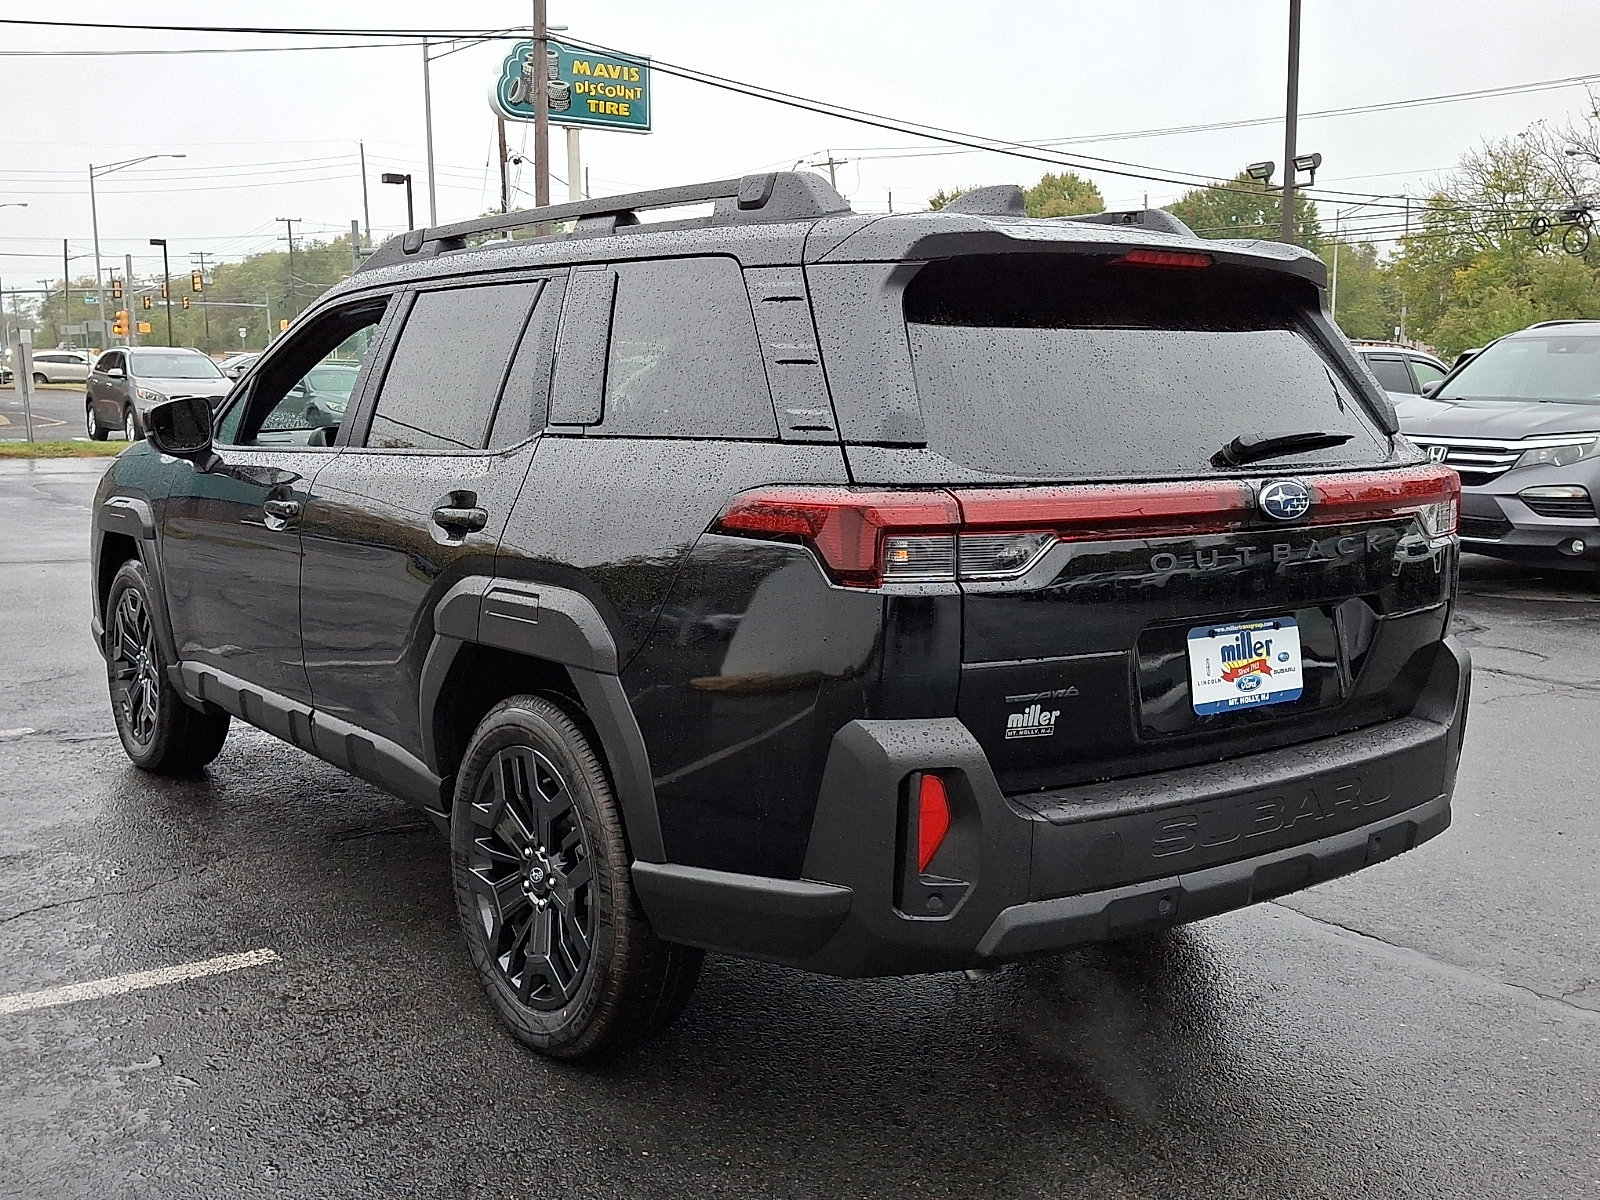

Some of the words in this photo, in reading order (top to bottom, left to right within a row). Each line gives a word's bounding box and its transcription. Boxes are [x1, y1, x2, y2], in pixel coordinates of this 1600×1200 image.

[572, 60, 641, 82] MAVIS
[574, 80, 643, 101] DISCOUNT
[586, 99, 631, 117] TIRE
[1150, 534, 1383, 573] OUTBACK
[1221, 631, 1273, 662] miller
[1241, 677, 1259, 690] Ford
[1007, 704, 1061, 728] miller
[1152, 771, 1393, 858] SUBARU
